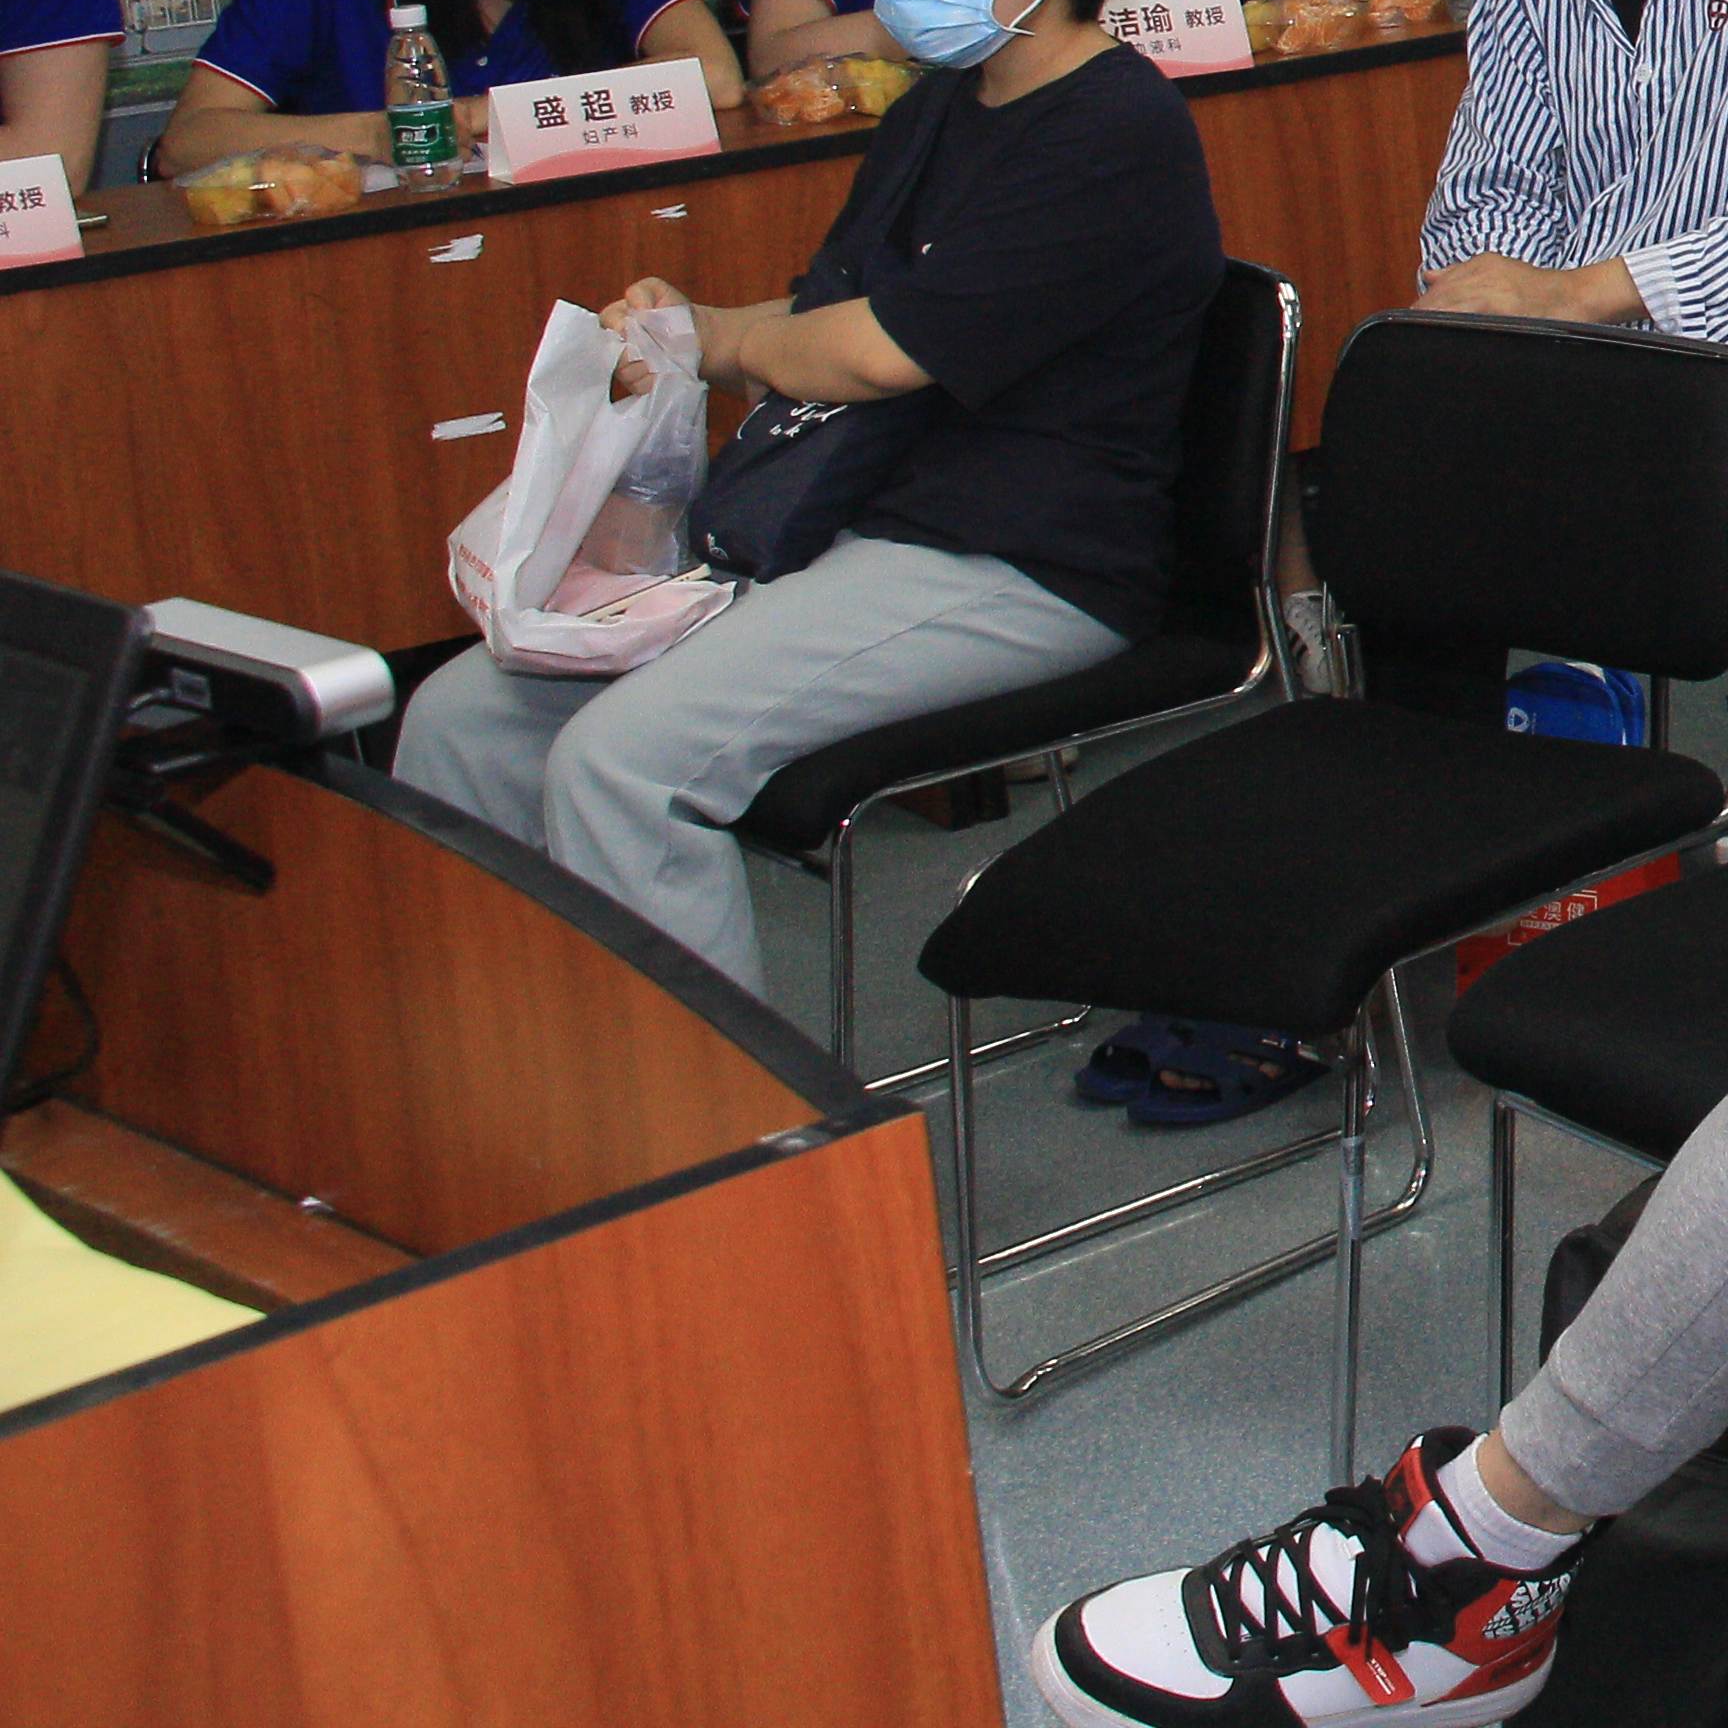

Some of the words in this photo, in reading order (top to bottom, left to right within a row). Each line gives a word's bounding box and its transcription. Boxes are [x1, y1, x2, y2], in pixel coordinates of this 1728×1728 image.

[1099, 3, 1174, 37] 洁瑜
[1184, 6, 1226, 29] 教授
[629, 90, 676, 116] 教授
[583, 123, 639, 145] 妇产科
